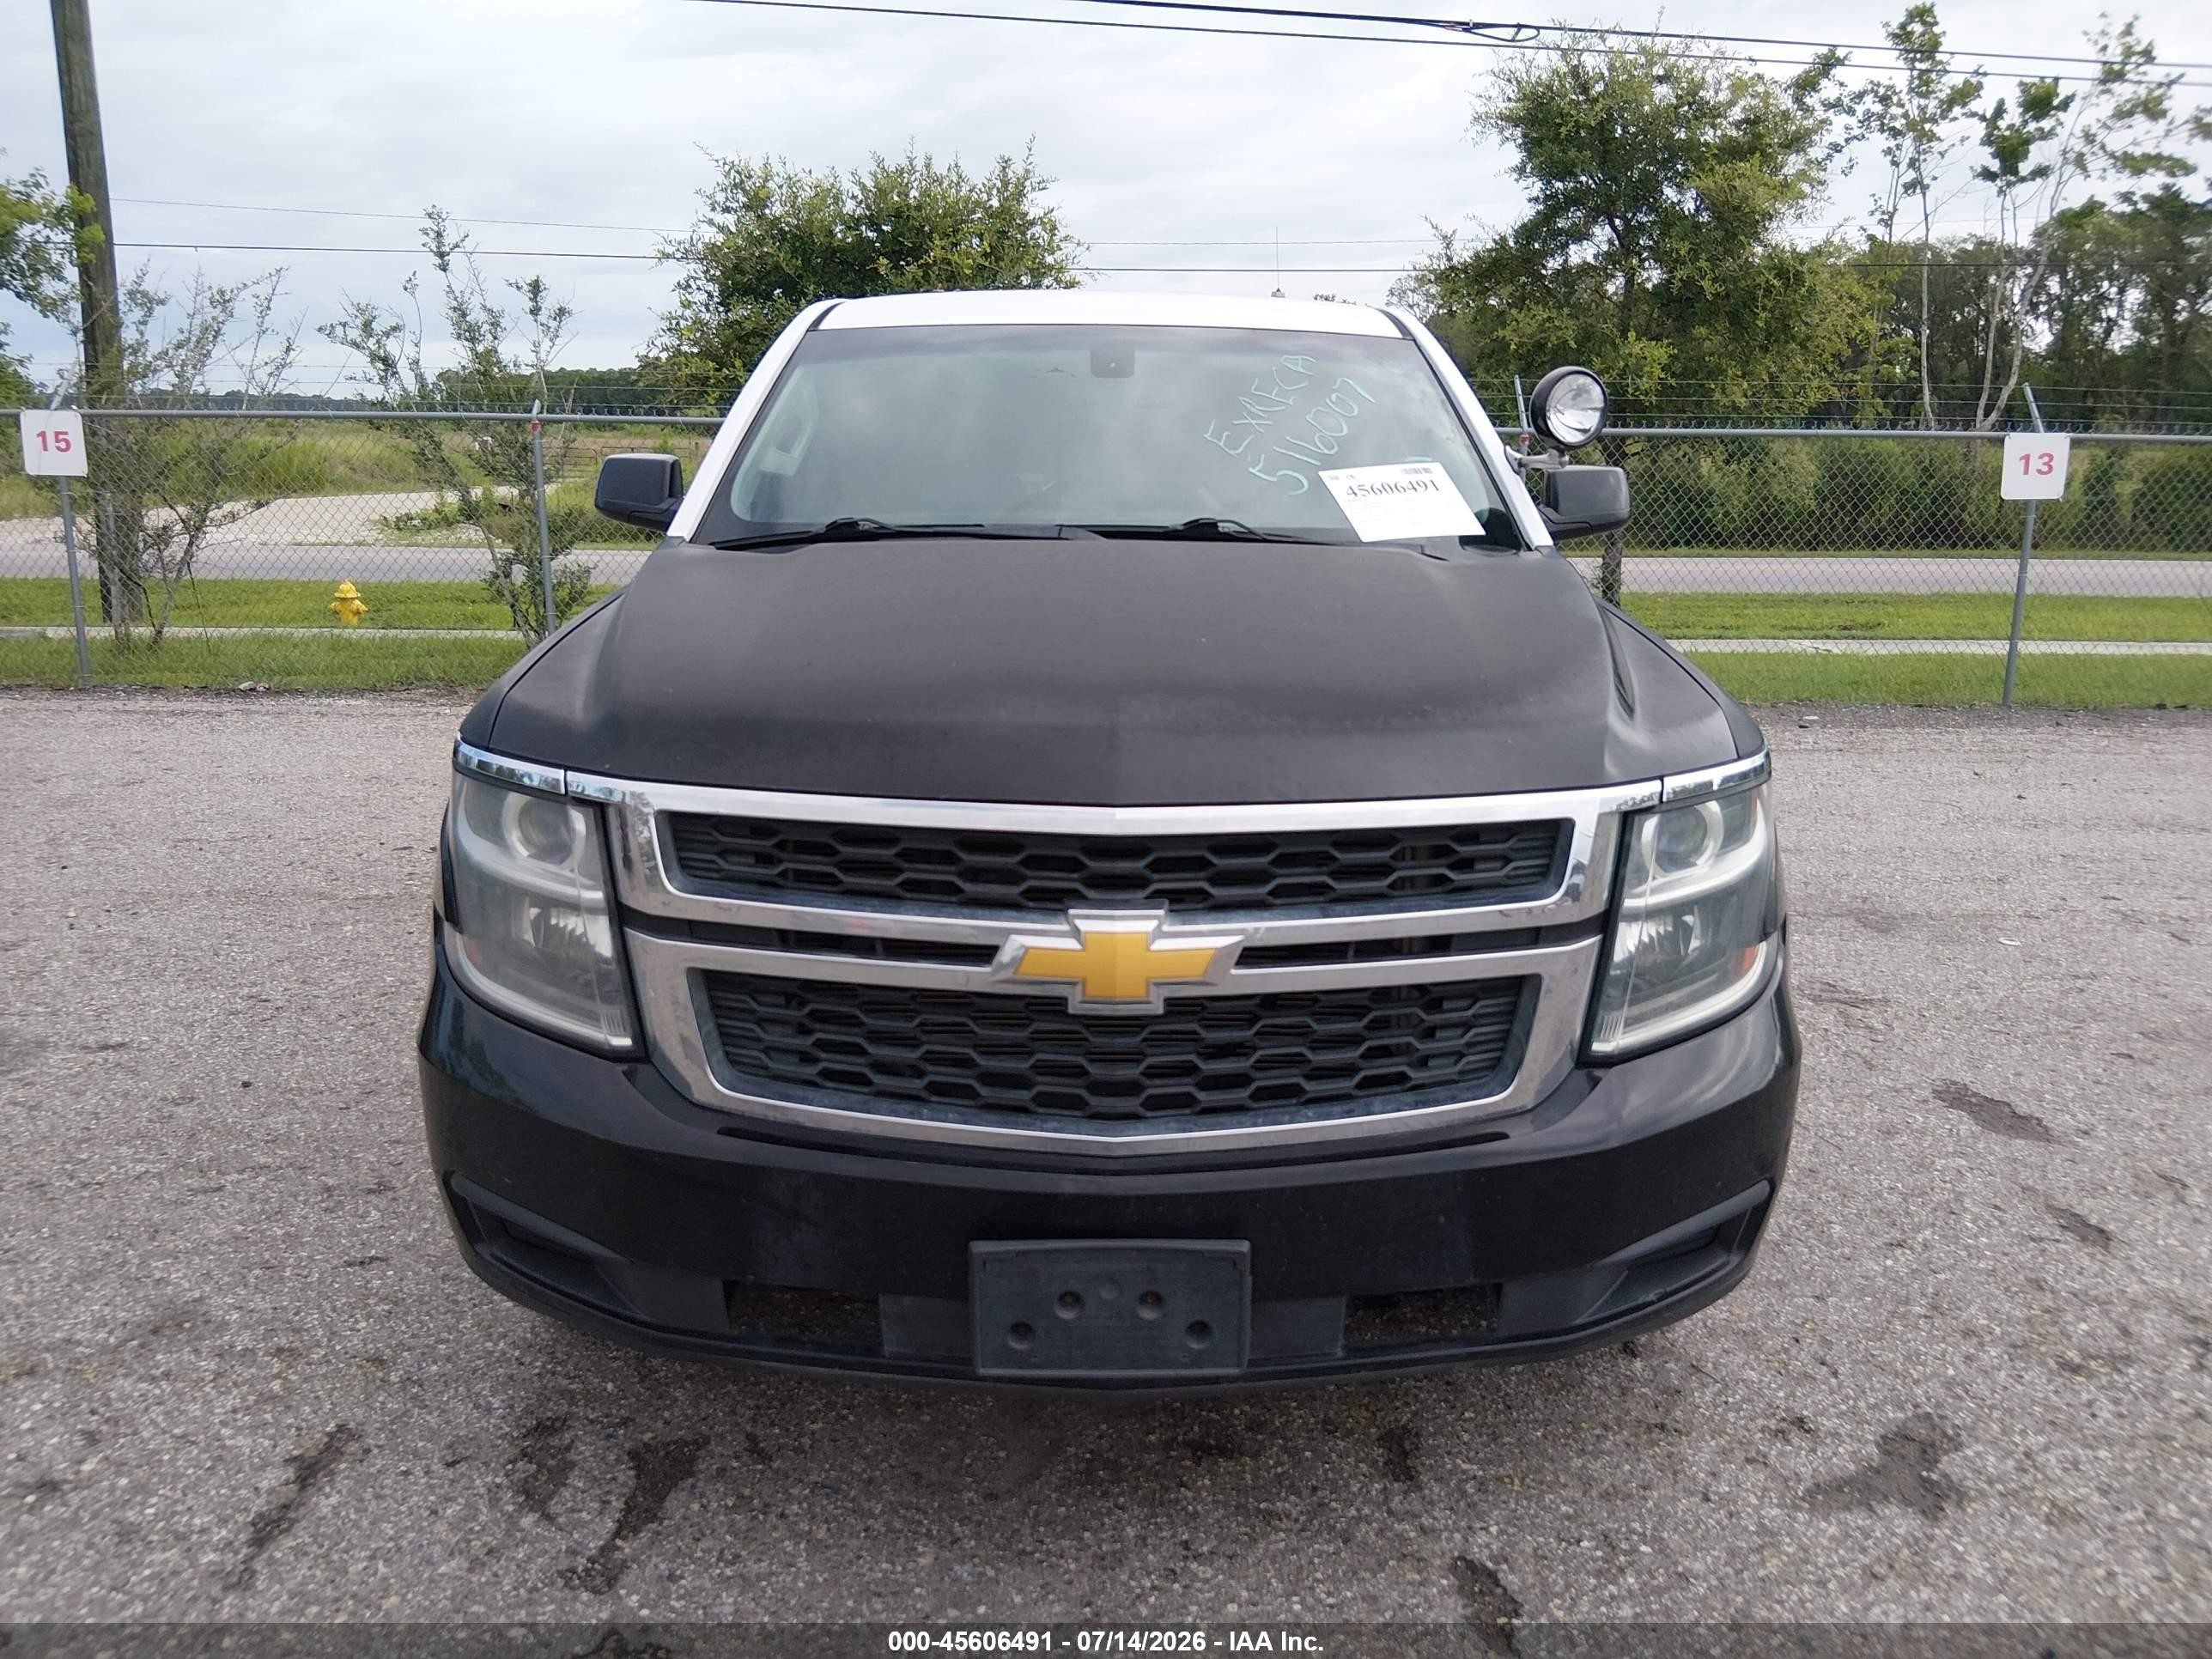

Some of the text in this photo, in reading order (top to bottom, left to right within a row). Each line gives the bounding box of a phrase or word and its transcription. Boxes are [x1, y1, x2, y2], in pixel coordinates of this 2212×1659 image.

[36, 430, 71, 453] 15
[1248, 377, 1375, 495] 516007
[2019, 453, 2054, 475] 13
[1346, 479, 1439, 497] 45606491
